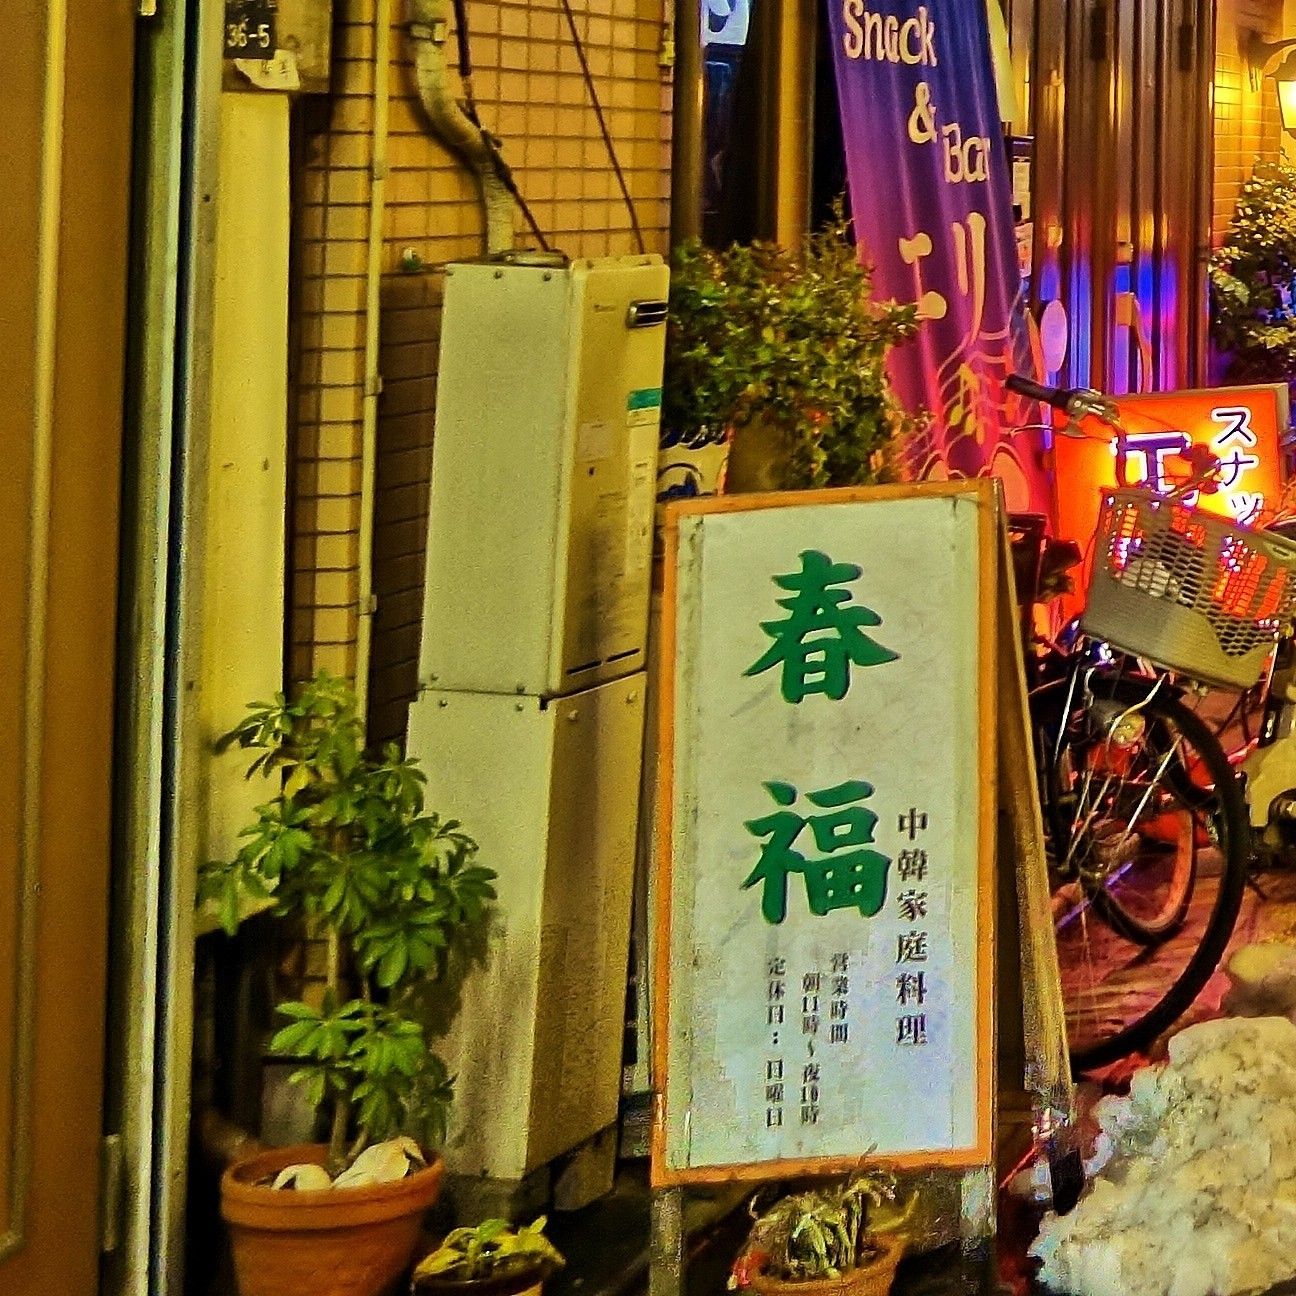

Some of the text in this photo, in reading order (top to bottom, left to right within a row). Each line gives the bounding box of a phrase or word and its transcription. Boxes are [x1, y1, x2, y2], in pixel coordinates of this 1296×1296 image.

[906, 81, 939, 145] &
[942, 122, 990, 183] Bar
[898, 211, 987, 338] エリ
[743, 549, 900, 925] 春福
[895, 806, 929, 1048] 中韓家庭料理
